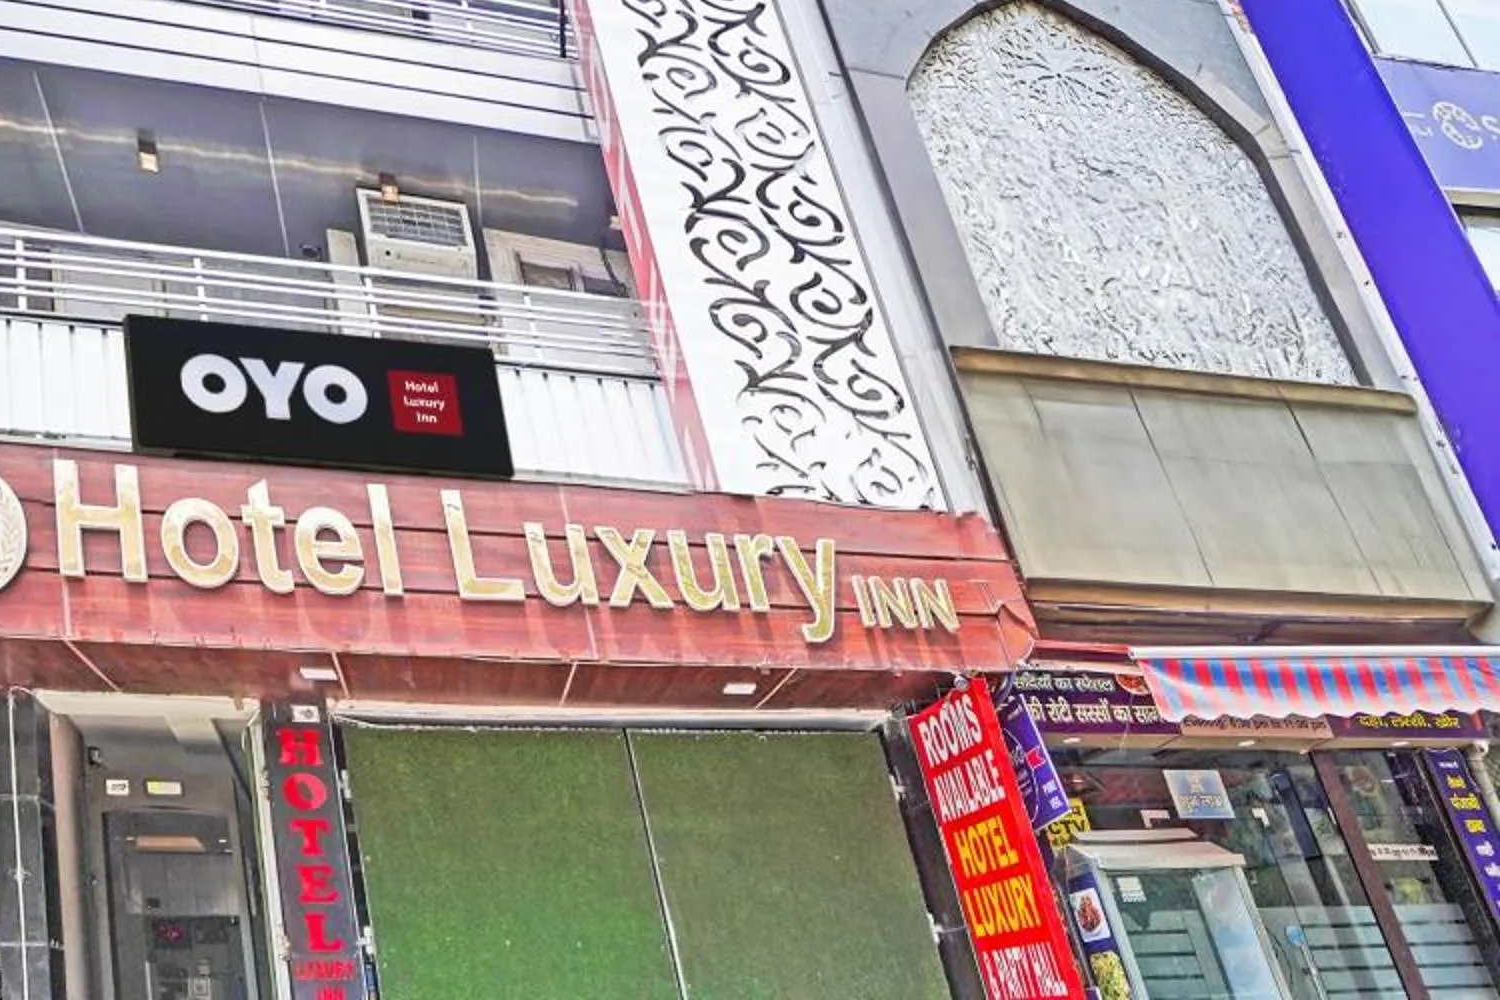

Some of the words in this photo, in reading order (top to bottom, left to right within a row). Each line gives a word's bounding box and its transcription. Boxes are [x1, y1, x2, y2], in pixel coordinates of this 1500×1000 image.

[180, 353, 368, 425] OYO
[403, 395, 445, 412] Luxury
[404, 380, 439, 393] Hotel
[416, 411, 437, 423] Inn
[53, 458, 404, 598] Hotel
[440, 489, 836, 643] Luxury
[851, 575, 960, 635] INN
[917, 694, 983, 768] ROOMS
[933, 749, 1005, 822] AVAILABLE
[276, 727, 345, 953] HOTEL
[953, 815, 1019, 878] HOTEL
[964, 873, 1043, 938] LUXURY
